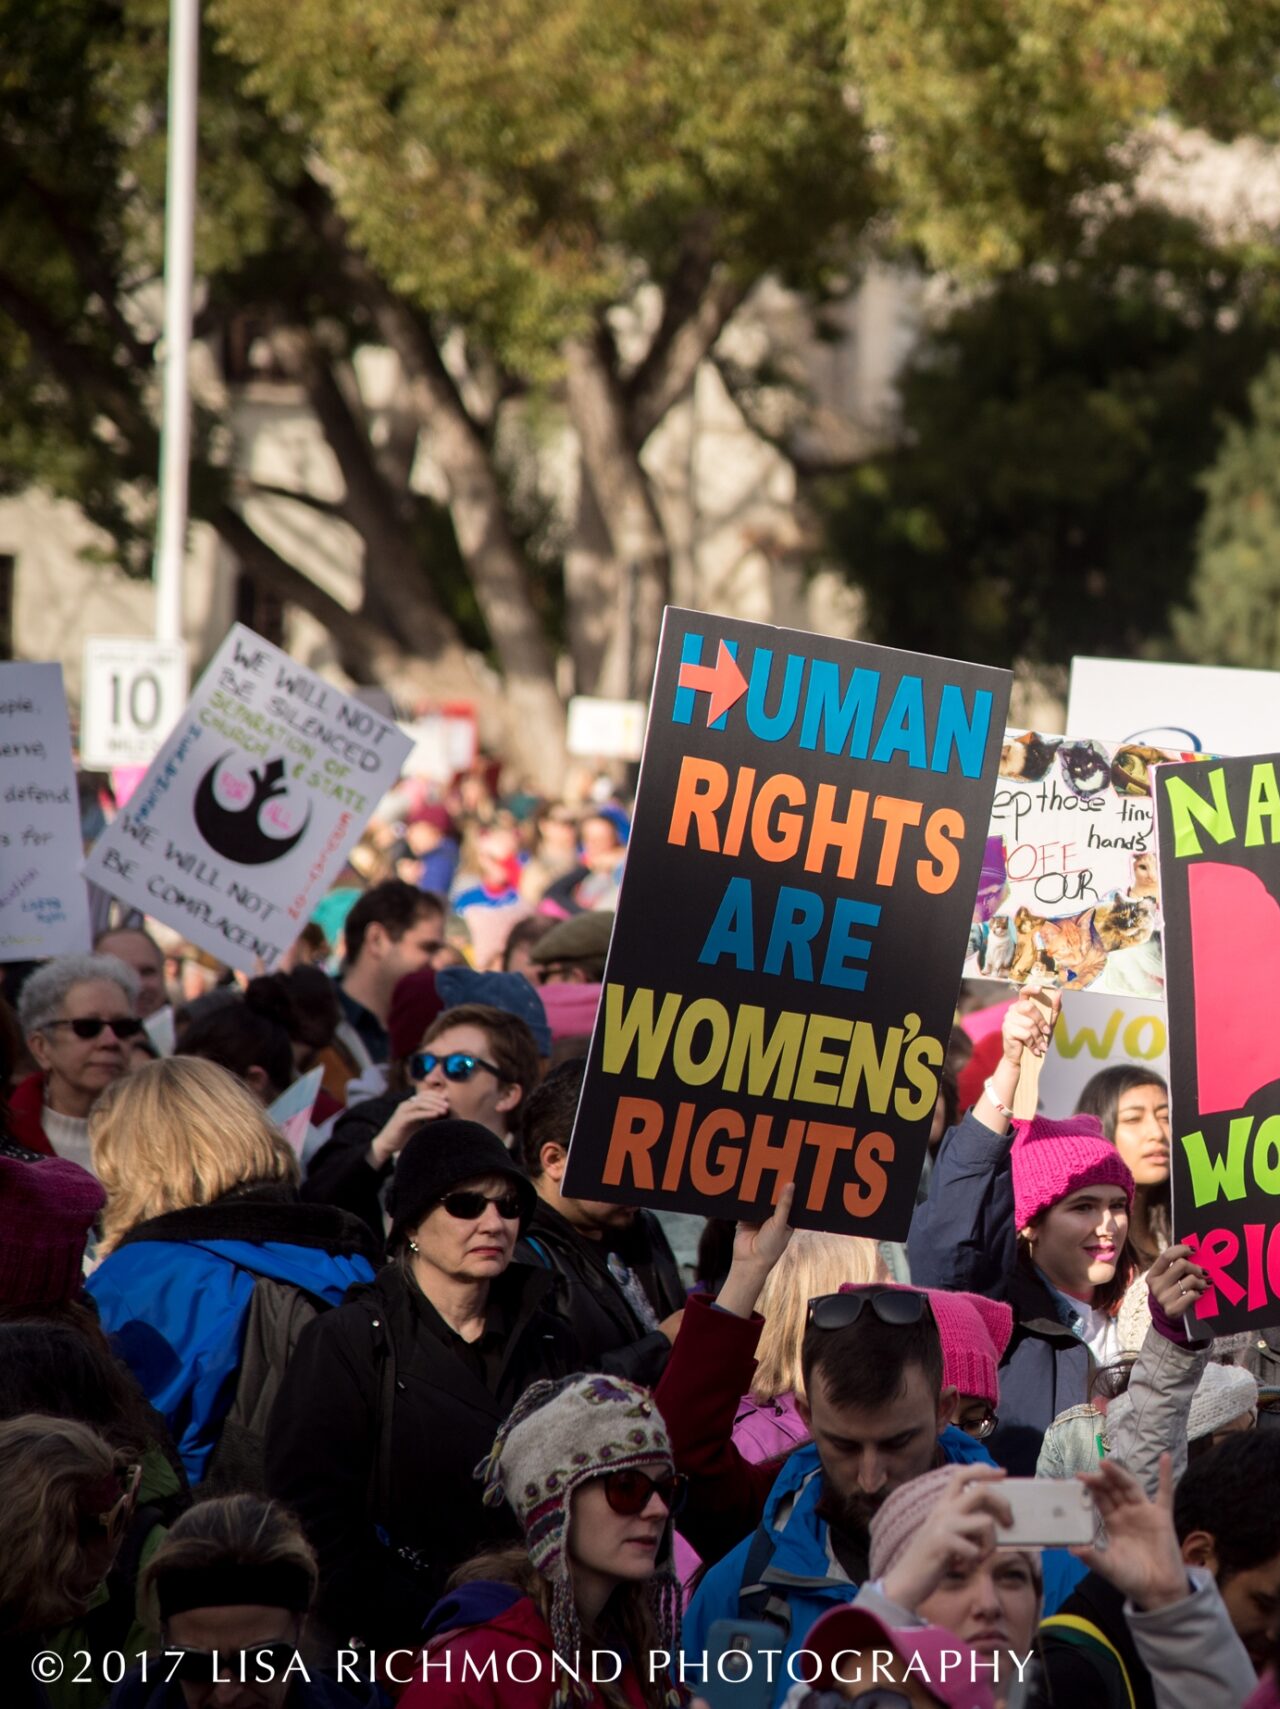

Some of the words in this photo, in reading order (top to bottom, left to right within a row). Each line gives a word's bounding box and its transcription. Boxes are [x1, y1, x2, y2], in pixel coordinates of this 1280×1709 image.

[110, 668, 163, 732] 10
[217, 666, 256, 704] BE
[264, 694, 382, 773] SILENCED
[232, 639, 273, 678] WE
[275, 666, 328, 712] WILL
[335, 704, 396, 745] NOT
[672, 632, 993, 780] HUMAN
[667, 756, 965, 895] RIGHTS
[1036, 780, 1106, 812] those
[1087, 823, 1148, 852] hands
[102, 846, 140, 884] BE
[146, 873, 283, 966] COMPLACENT
[120, 814, 160, 848] WE
[163, 840, 222, 891] WILL
[226, 880, 284, 922] NOT
[1007, 841, 1077, 881] OFF
[1034, 867, 1099, 903] OUR
[698, 877, 882, 991] ARE
[602, 983, 943, 1122] WOMEN'S
[601, 1096, 895, 1218] RIGHTS
